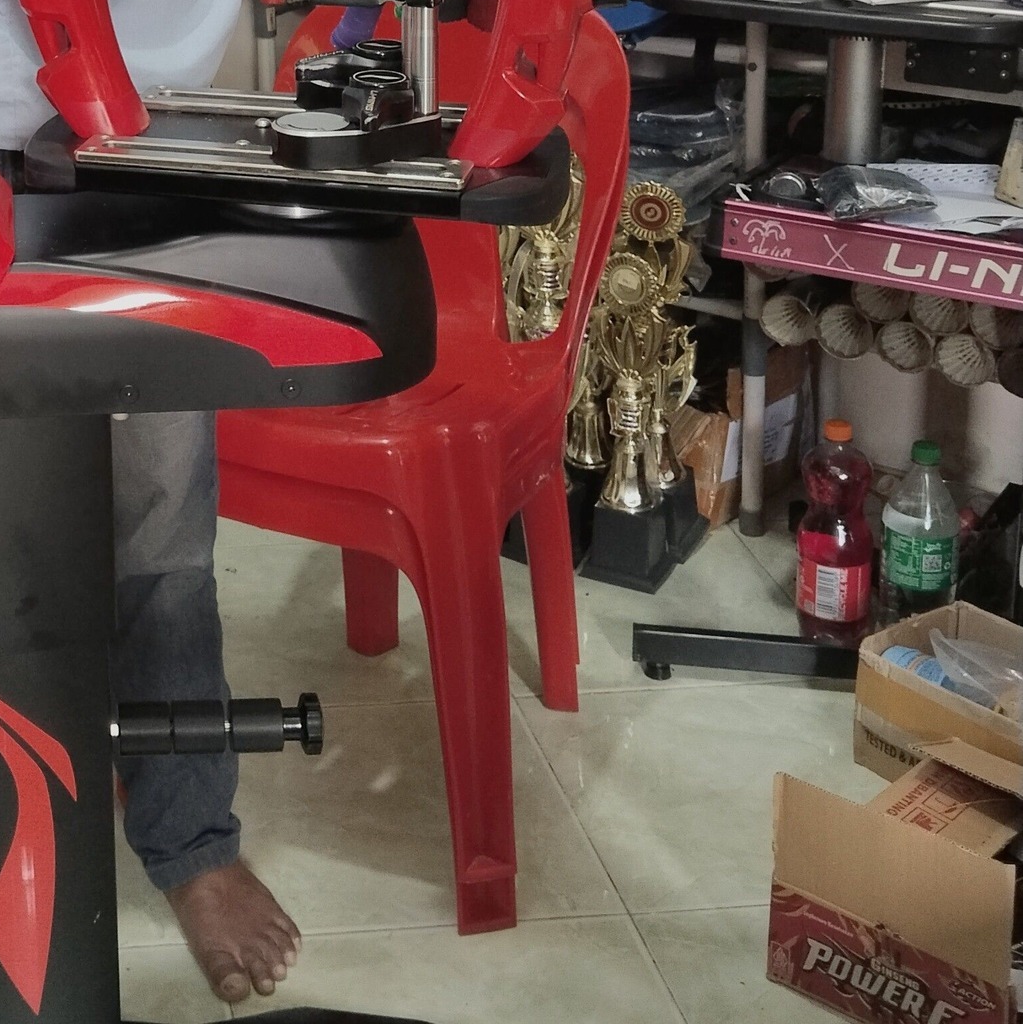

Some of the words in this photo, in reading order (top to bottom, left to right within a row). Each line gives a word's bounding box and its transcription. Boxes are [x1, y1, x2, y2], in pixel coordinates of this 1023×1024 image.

[883, 242, 1023, 295] LI-N
[864, 728, 897, 759] TESTED
[886, 779, 939, 817] DIBANTING
[803, 937, 925, 1019] POWER
[870, 957, 920, 992] GINSENG
